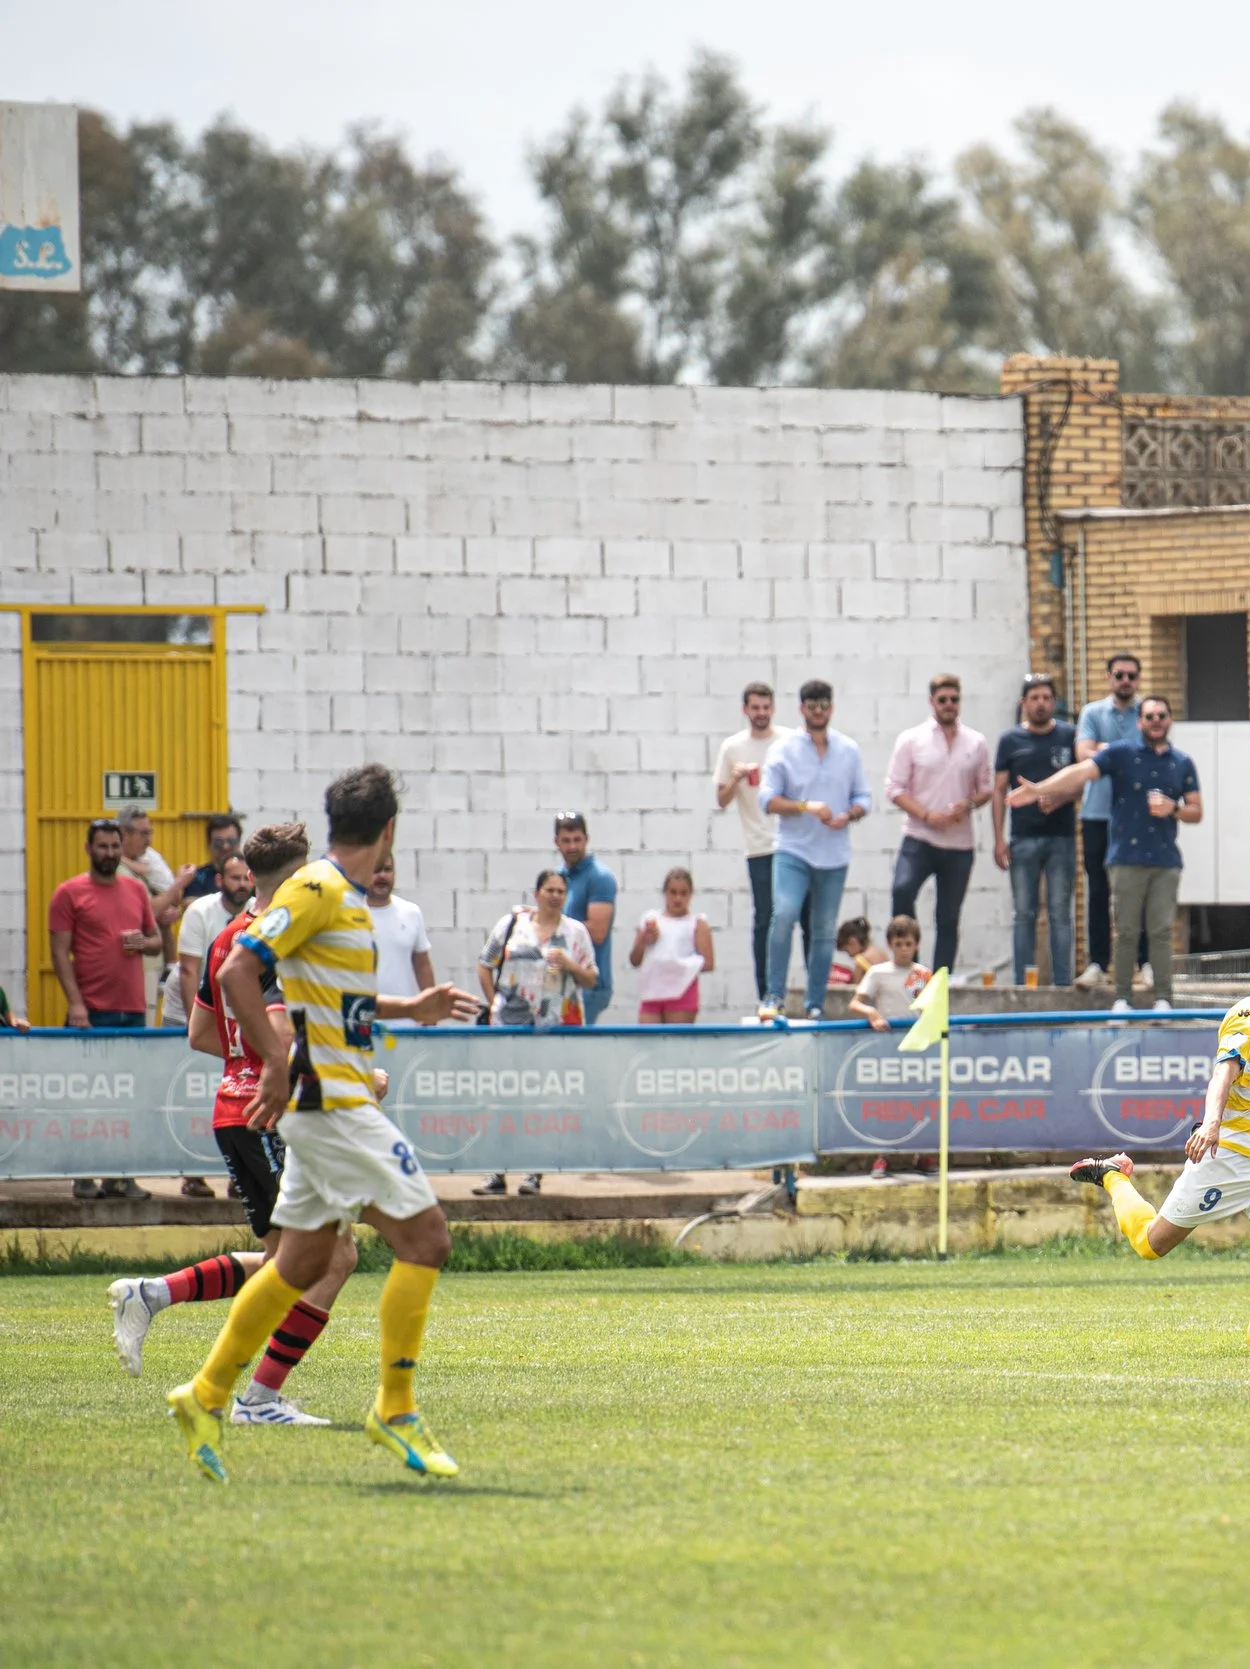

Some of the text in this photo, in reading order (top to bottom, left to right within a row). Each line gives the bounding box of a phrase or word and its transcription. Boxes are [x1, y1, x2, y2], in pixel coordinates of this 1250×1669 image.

[0, 1073, 135, 1099] RROCAR
[415, 1069, 585, 1097] BERROCAR
[636, 1066, 805, 1095] BERROCAR
[641, 1109, 799, 1134] RENT A CAR
[949, 1099, 972, 1121] A
[978, 1098, 1047, 1121] CAR
[44, 1118, 63, 1138] A
[70, 1117, 130, 1140] CAR
[420, 1112, 581, 1136] RENT A CAR
[1199, 1187, 1223, 1212] 9
